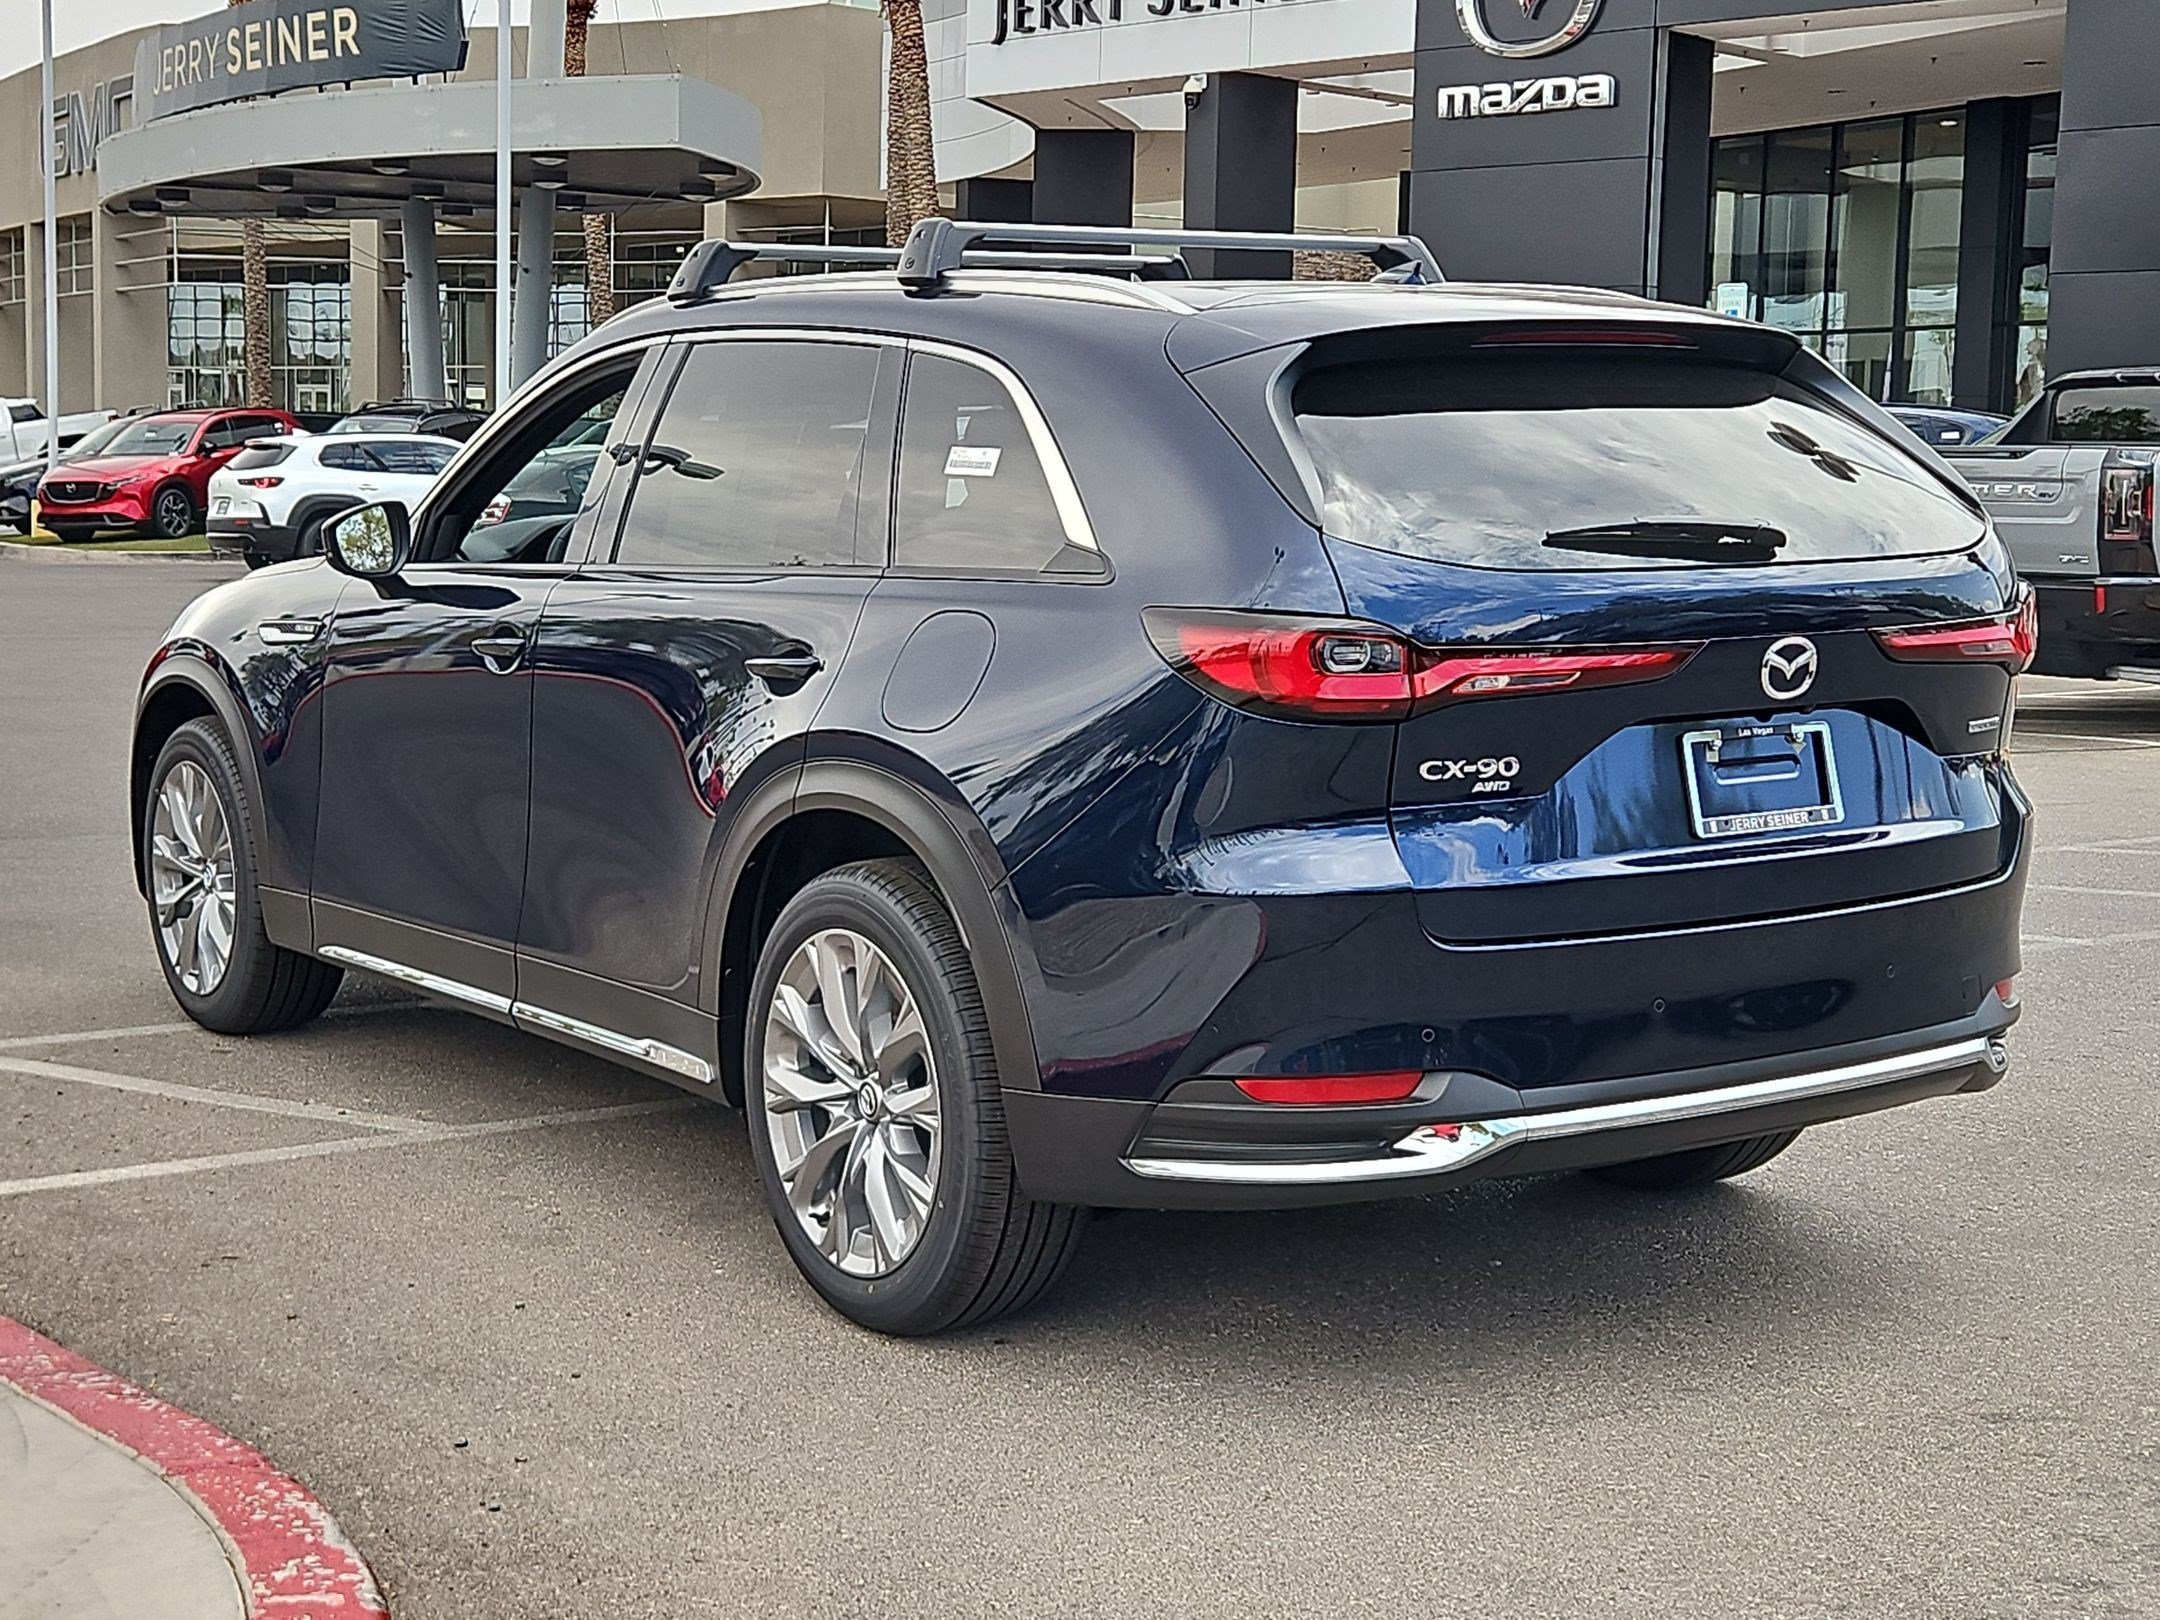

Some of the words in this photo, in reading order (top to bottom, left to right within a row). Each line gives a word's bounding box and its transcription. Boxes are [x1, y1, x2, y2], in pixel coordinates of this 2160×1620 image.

[153, 32, 220, 95] JERRY
[226, 7, 360, 75] SEINER
[1419, 756, 1520, 781] CX-90
[1471, 780, 1511, 793] AWD
[1730, 817, 1765, 831] JERRY
[1766, 811, 1809, 827] SEINER
